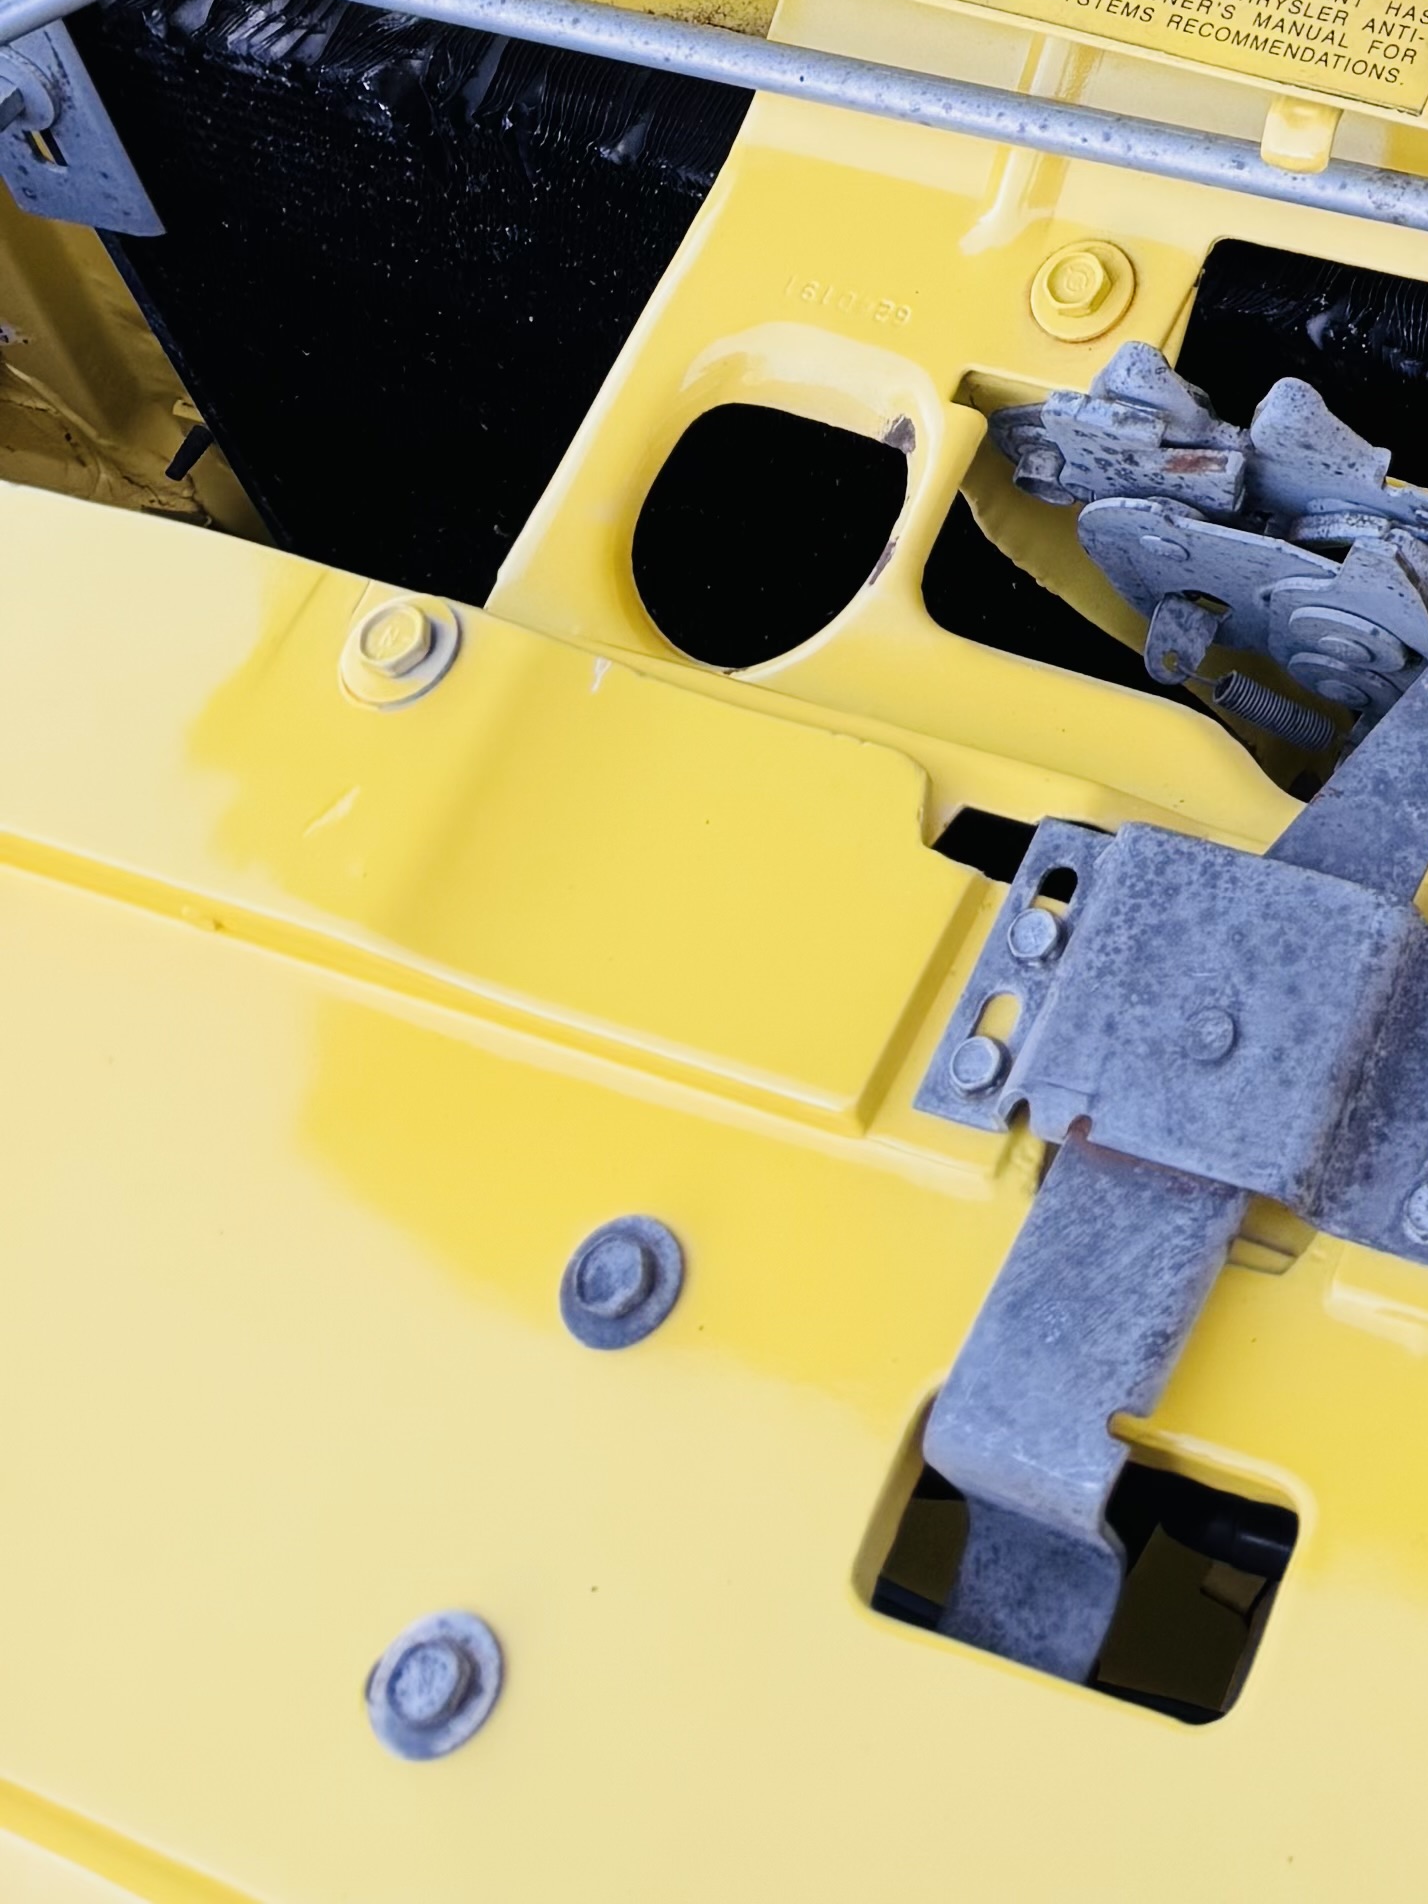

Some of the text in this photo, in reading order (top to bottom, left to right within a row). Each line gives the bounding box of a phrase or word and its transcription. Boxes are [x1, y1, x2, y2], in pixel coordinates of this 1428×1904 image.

[1163, 11, 1411, 88] RECOMMENDATIONS.
[1250, 9, 1354, 50] MANUAL
[1366, 37, 1420, 66] FOR
